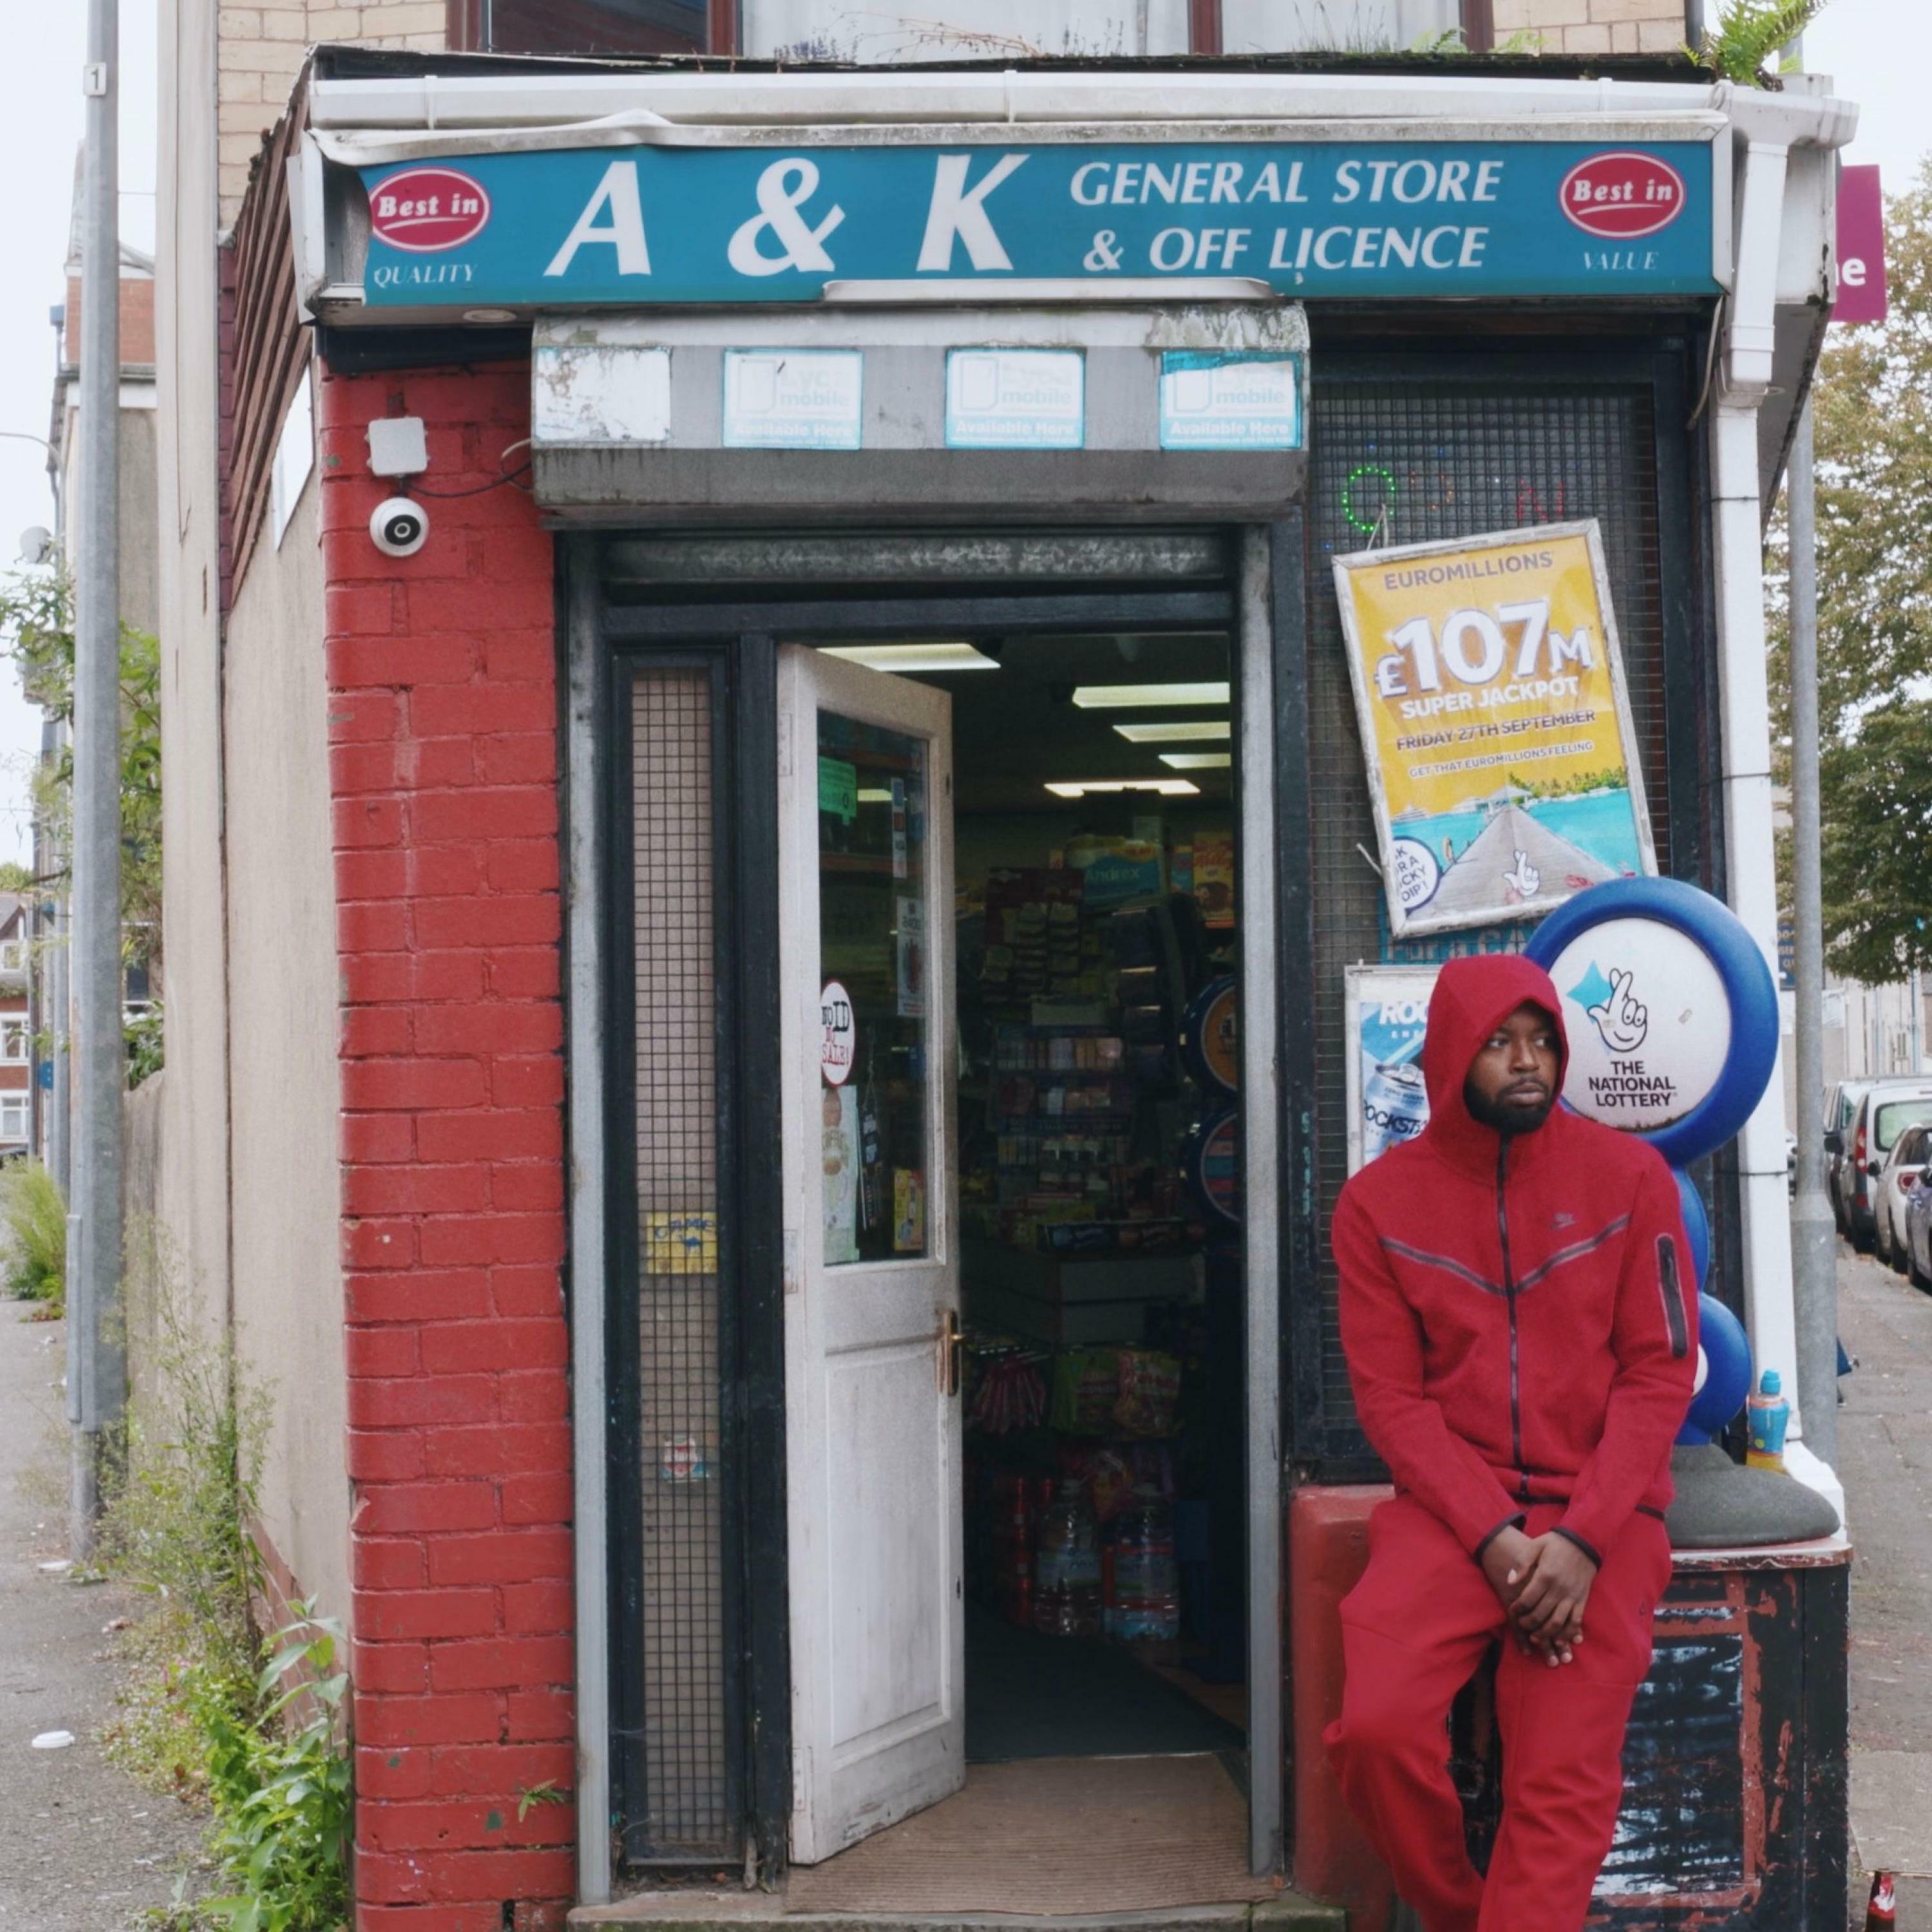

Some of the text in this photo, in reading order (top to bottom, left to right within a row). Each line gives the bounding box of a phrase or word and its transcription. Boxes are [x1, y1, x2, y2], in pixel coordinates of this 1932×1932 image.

[91, 67, 99, 90] 1
[1070, 160, 1504, 205] GENERAL STORE
[1572, 179, 1672, 203] Best in
[378, 194, 478, 218] Best in
[543, 154, 1030, 276] A & K
[1083, 226, 1489, 272] & OFF LICENCE
[1582, 252, 1660, 270] VALUE
[374, 263, 477, 288] QUALITY
[1835, 258, 1866, 286] e
[1002, 389, 1071, 404] mobile
[1216, 389, 1286, 404] mobile
[1384, 551, 1553, 590] EUROMILLIONS
[1374, 600, 1594, 697] £107M
[1399, 676, 1579, 720] SUPER JACKPOT
[1396, 710, 1596, 750] FRIDAY 27TH SEPTEMBER
[1409, 741, 1593, 777] GET THAT EUROMILLIONS FEELING
[1410, 855, 1419, 866] A
[1400, 865, 1425, 888] CKY
[833, 1001, 849, 1032] ID
[1610, 1061, 1645, 1075] THE
[1589, 1077, 1676, 1091] NATIONAL
[1595, 1094, 1671, 1107] LOTTERY
